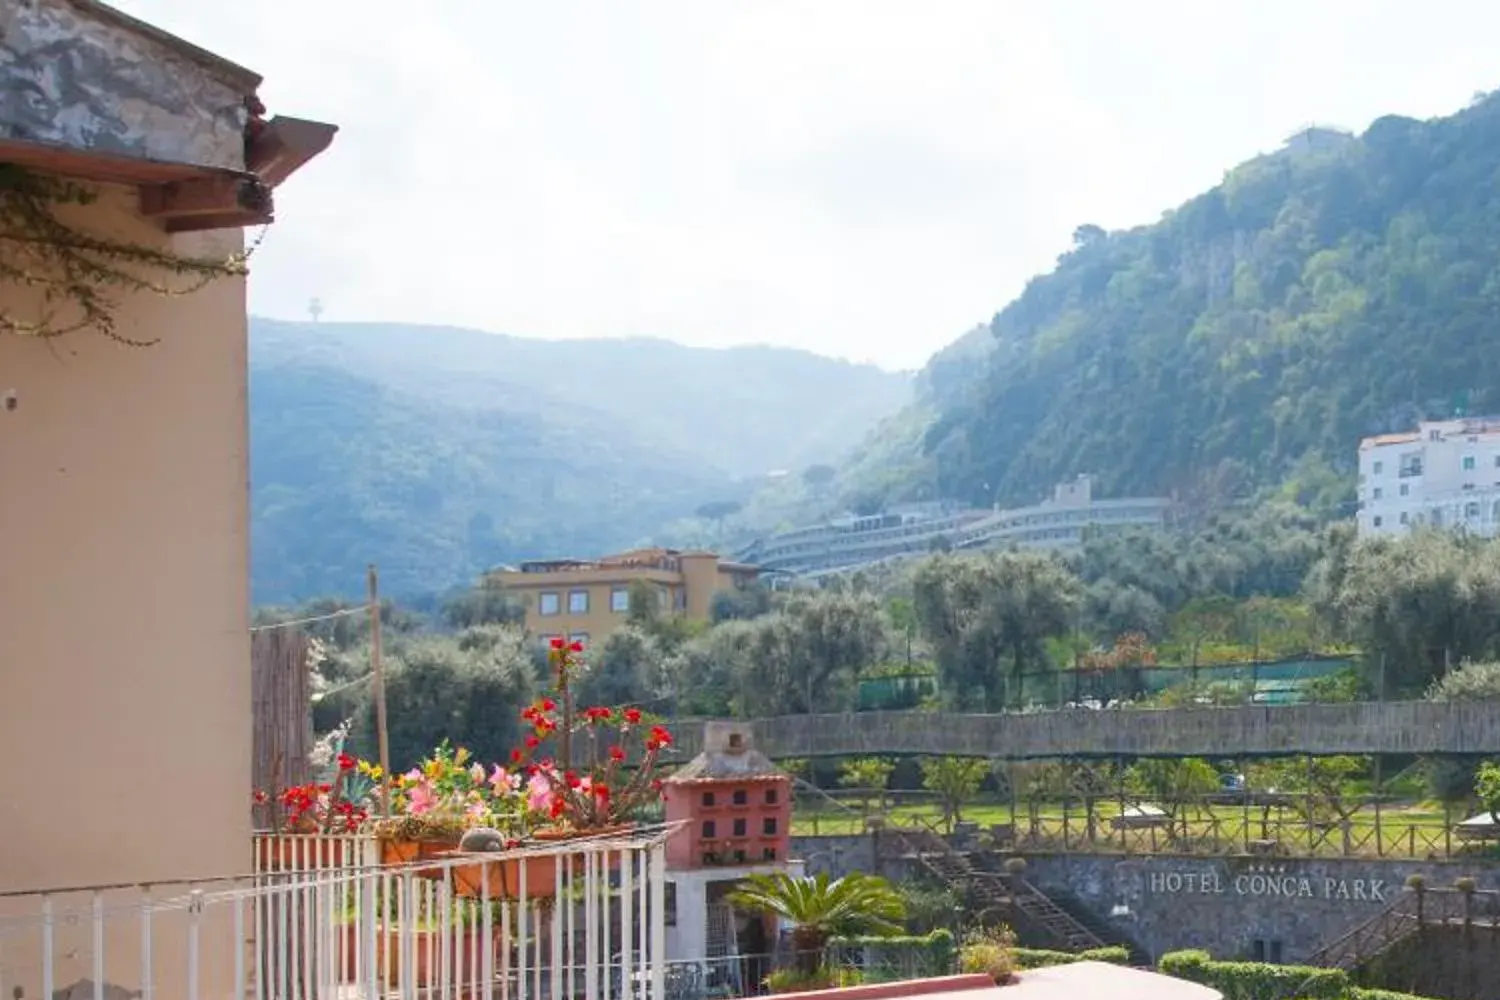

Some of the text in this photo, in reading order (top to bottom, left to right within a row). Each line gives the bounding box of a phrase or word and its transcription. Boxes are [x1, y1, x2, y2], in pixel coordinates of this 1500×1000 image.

[1150, 872, 1386, 901] HOTEL CONCA PARK
